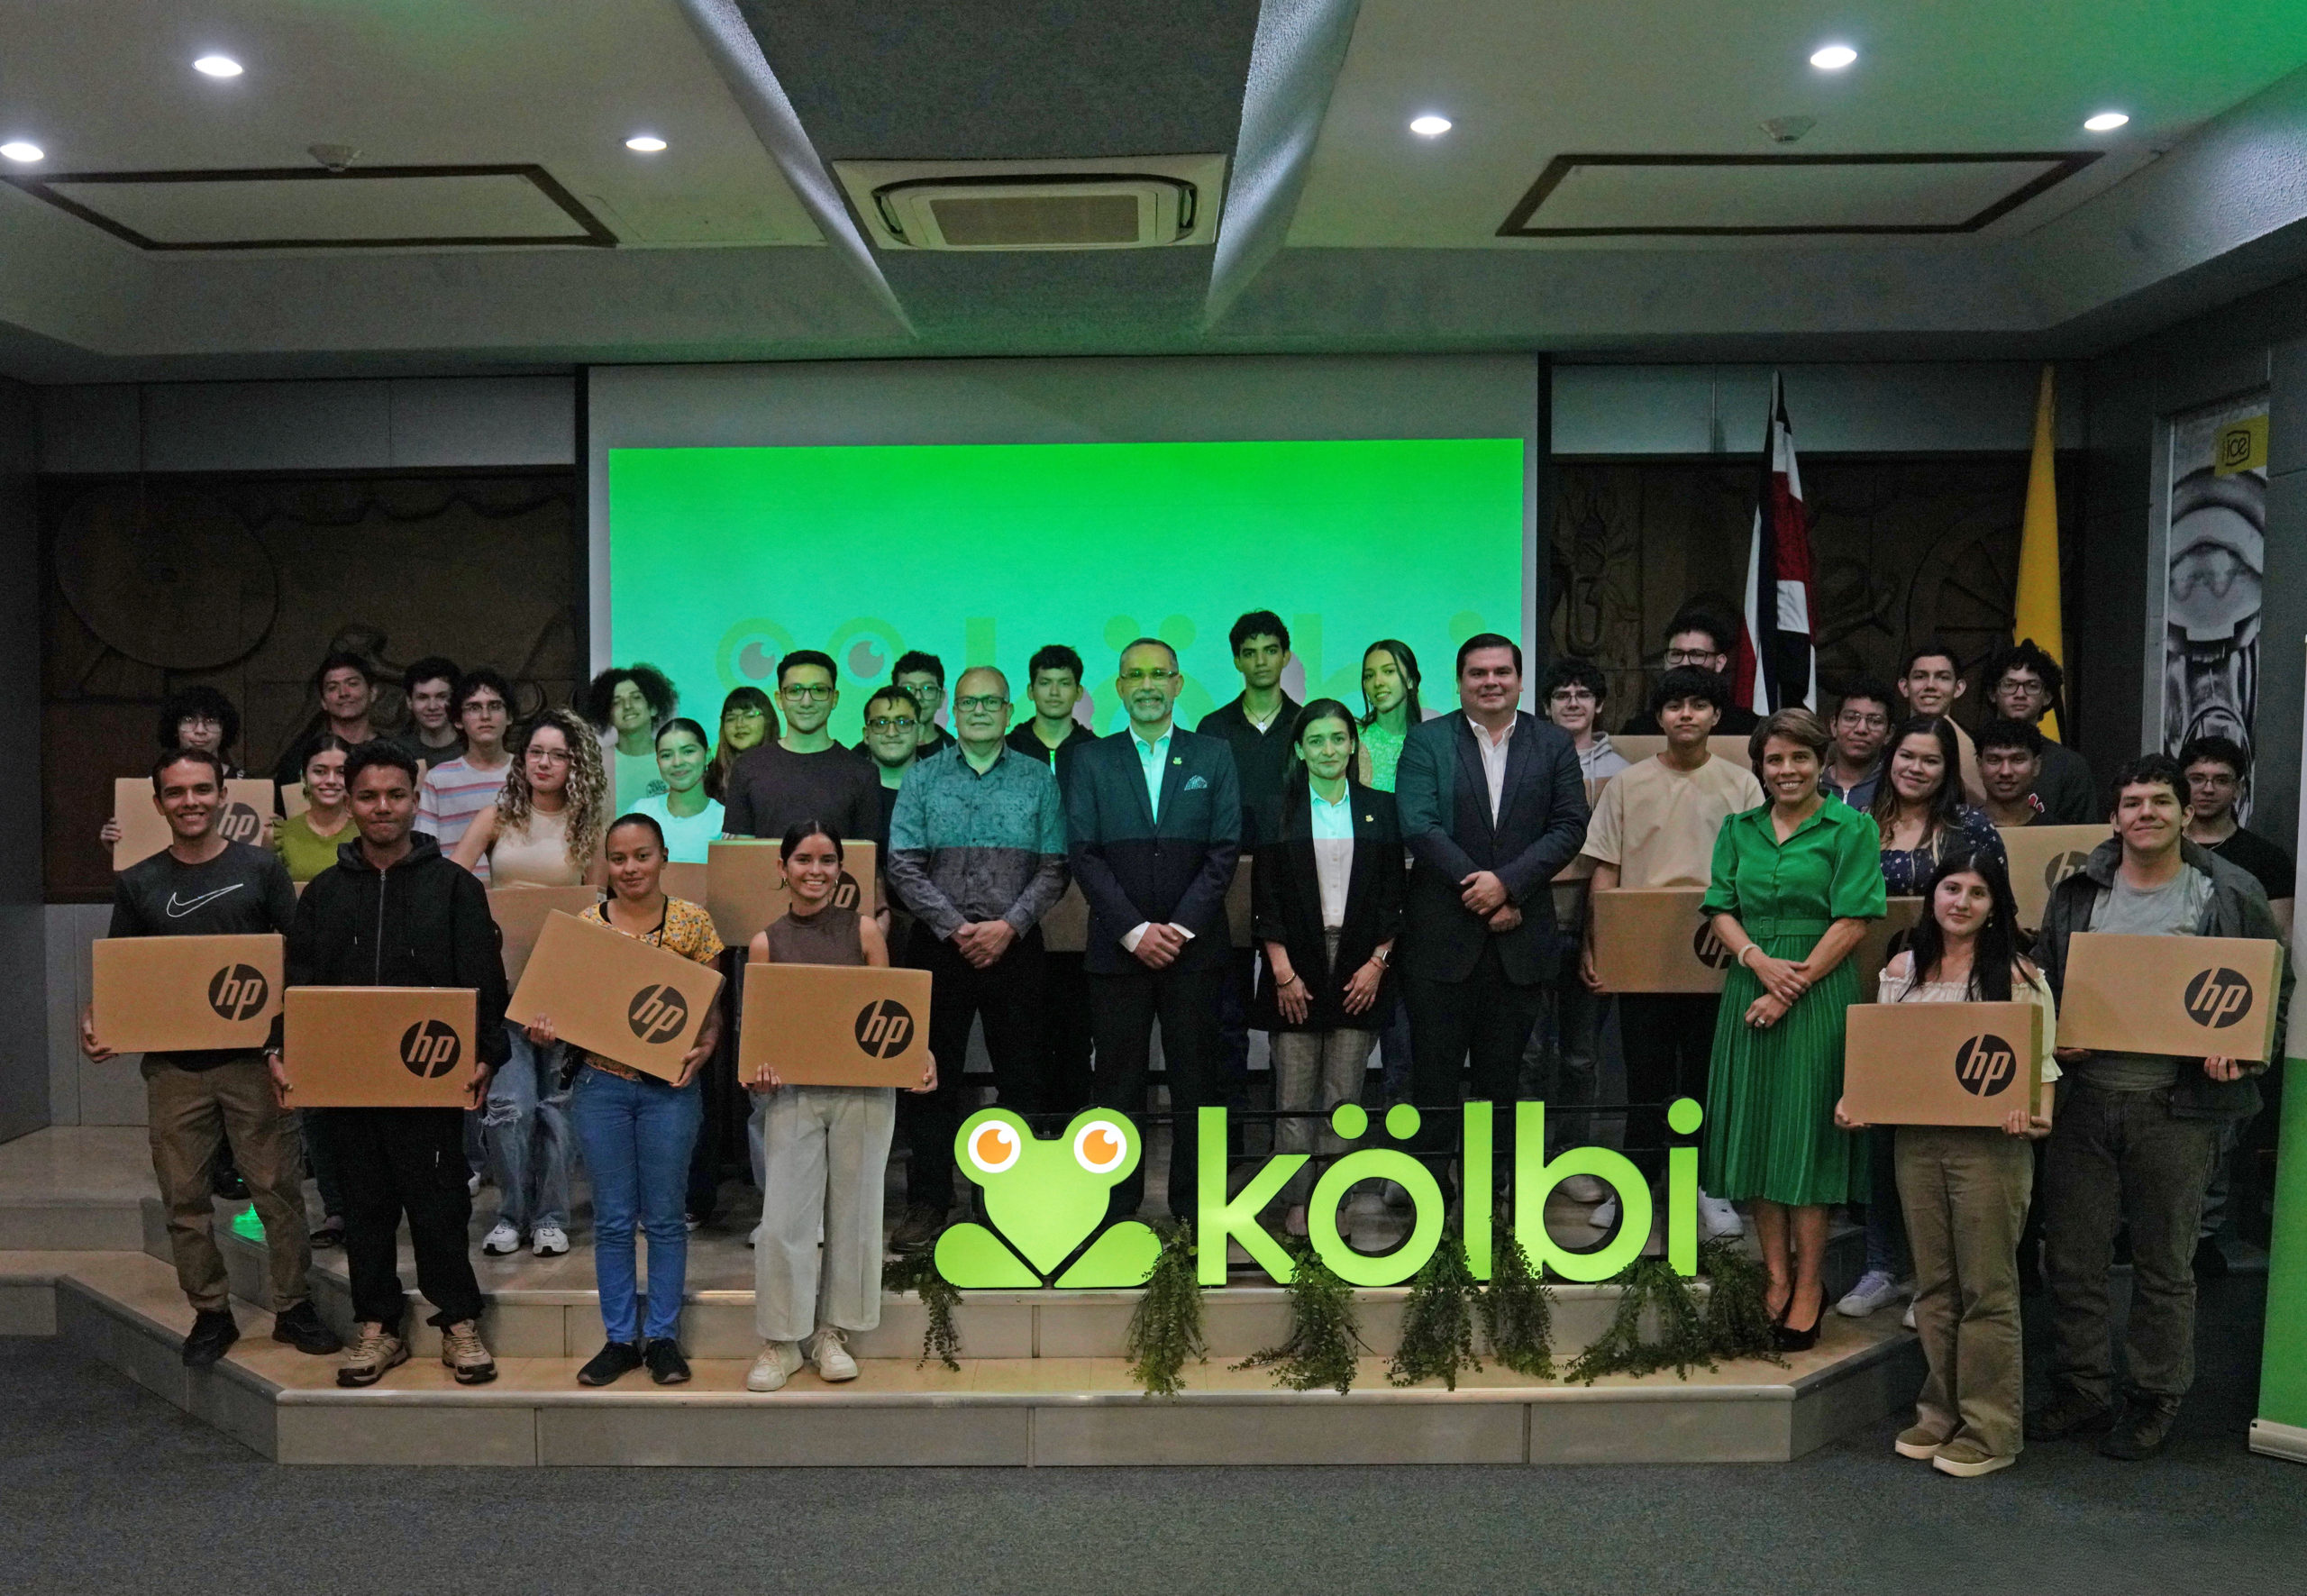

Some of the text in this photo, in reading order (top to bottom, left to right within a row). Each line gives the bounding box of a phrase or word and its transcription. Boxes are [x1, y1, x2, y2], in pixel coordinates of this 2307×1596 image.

[217, 801, 256, 842] hp
[215, 963, 262, 1021] hp
[632, 984, 684, 1042] hp
[2191, 967, 2248, 1028] hp
[406, 1019, 455, 1078] hp
[861, 999, 909, 1058] hp
[1962, 1034, 2011, 1097] hp
[1198, 1098, 1702, 1286] kölbi
